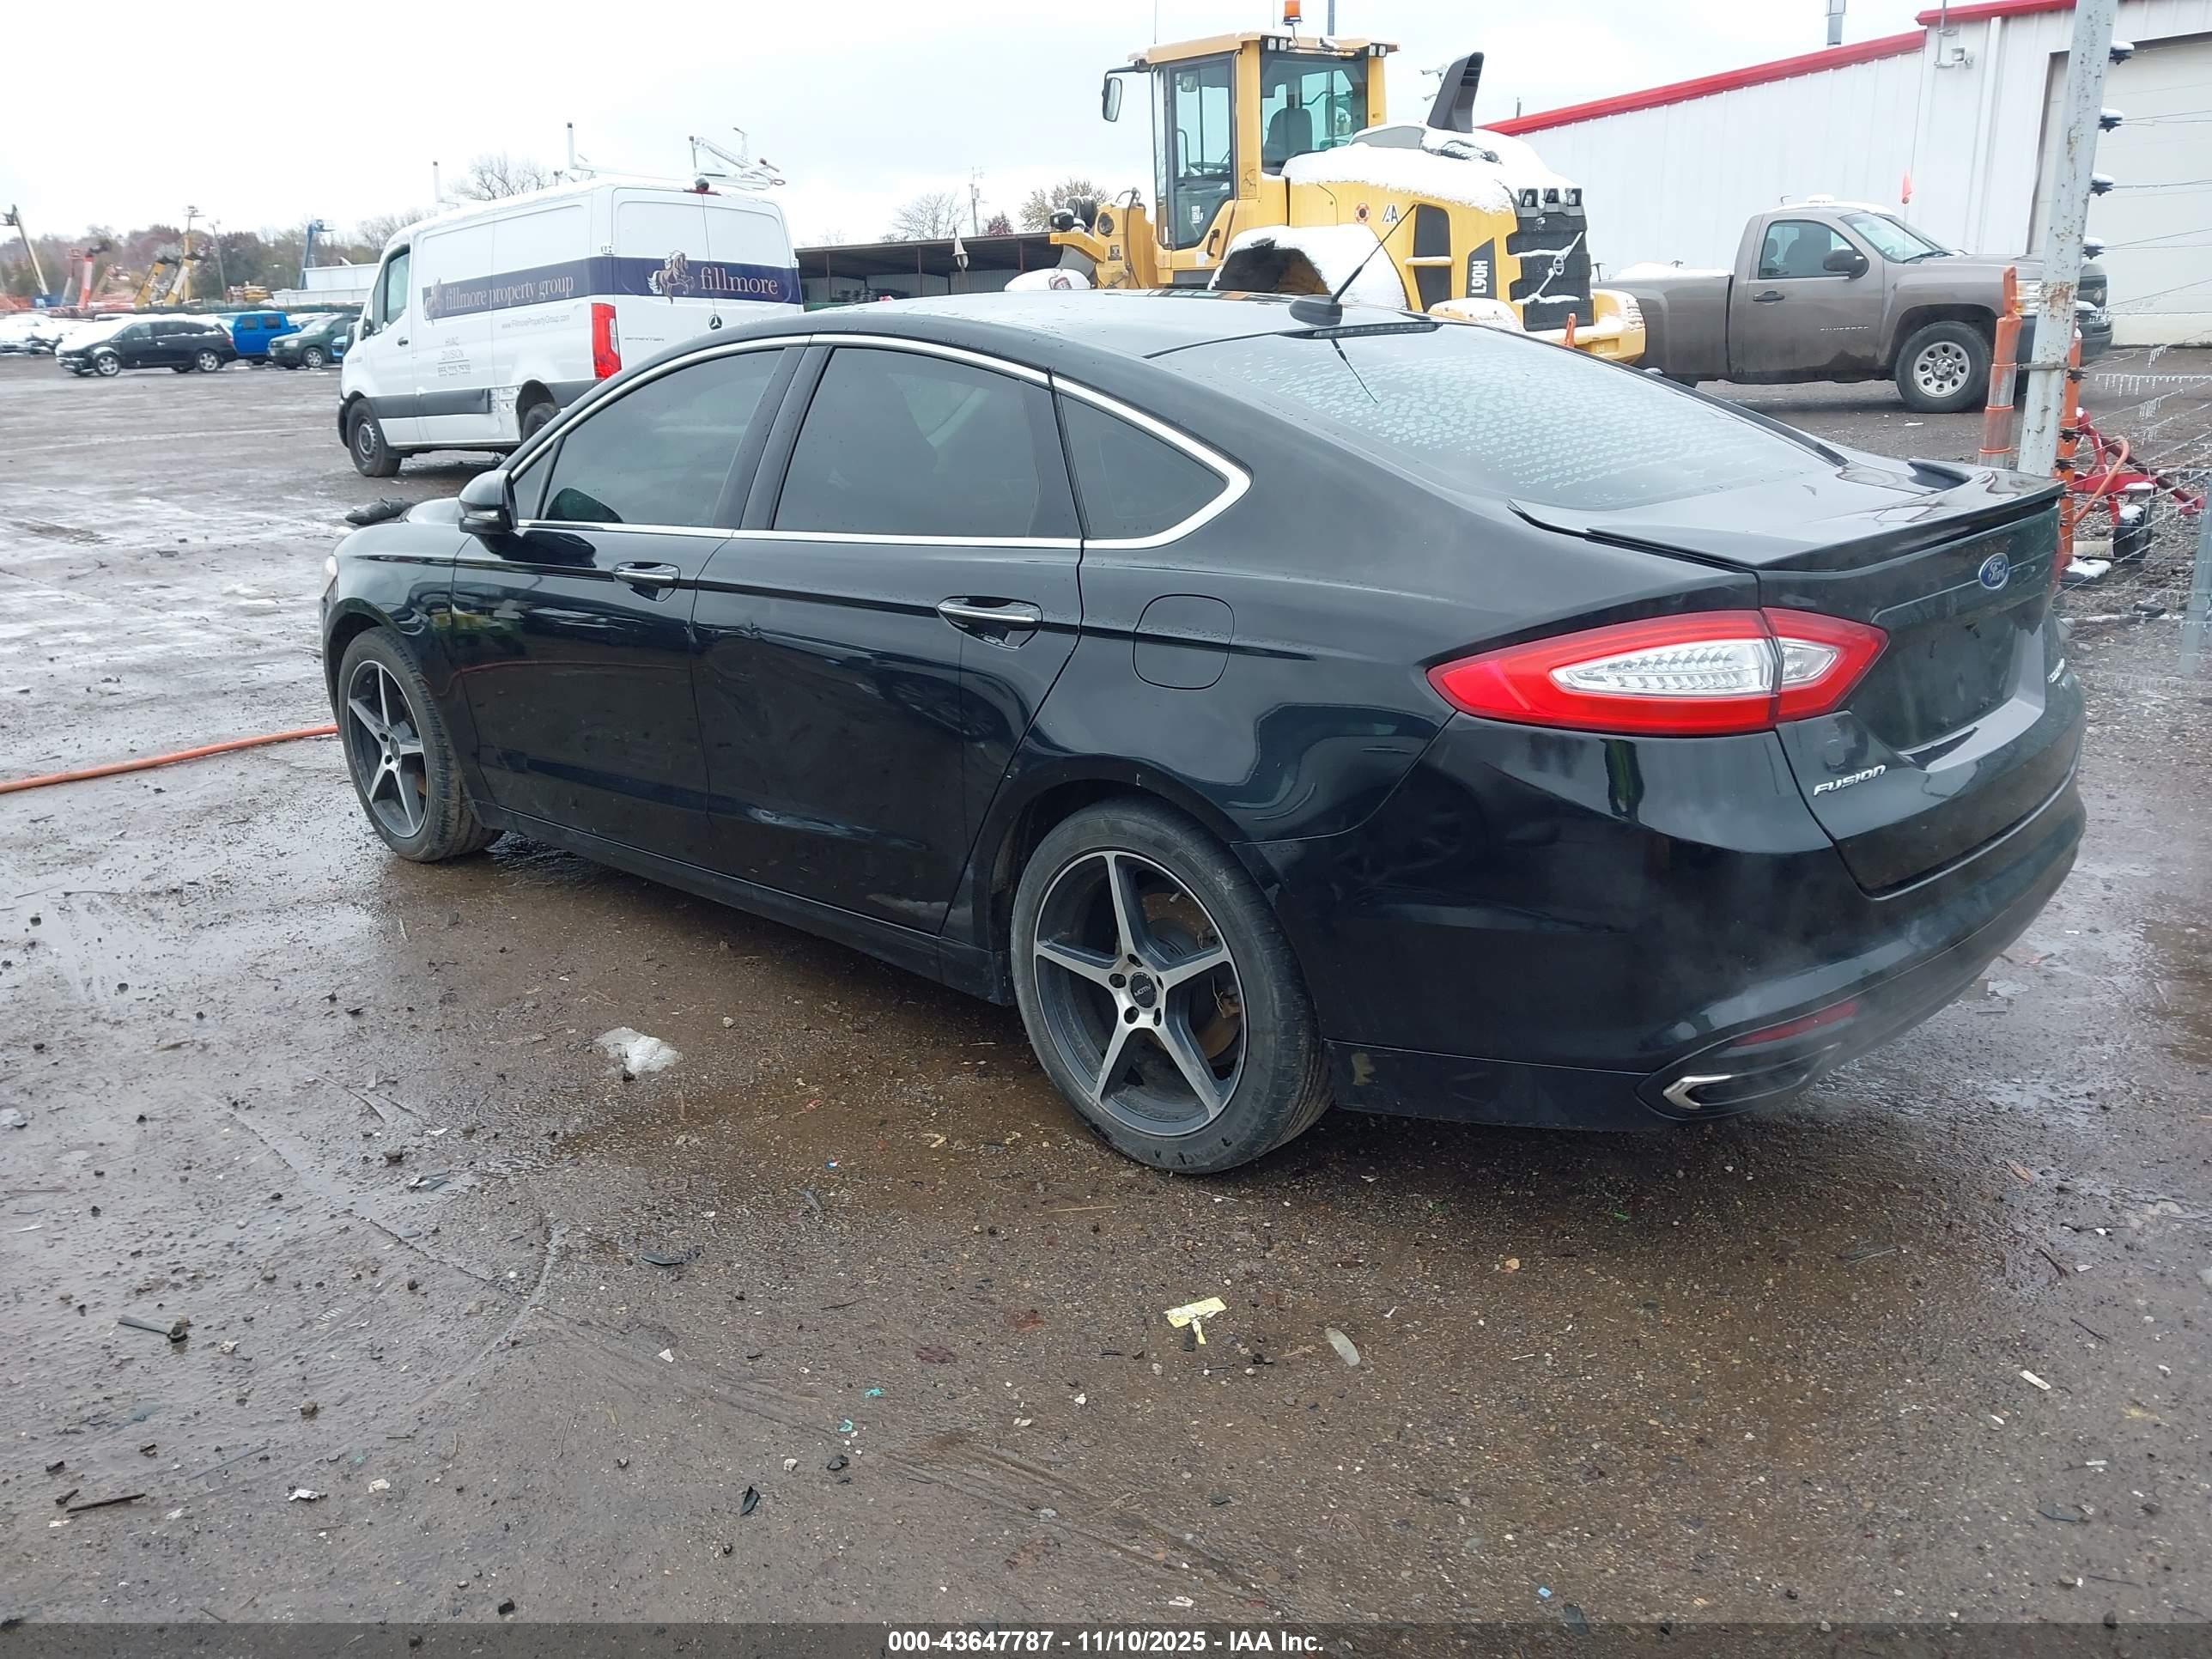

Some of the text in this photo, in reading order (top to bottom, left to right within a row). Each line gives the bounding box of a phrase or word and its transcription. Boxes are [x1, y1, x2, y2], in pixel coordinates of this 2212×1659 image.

[446, 276, 574, 310] fillmore property group
[701, 267, 778, 295] fillmore
[1471, 260, 1488, 294] L90H
[1814, 764, 1887, 796] FUSION
